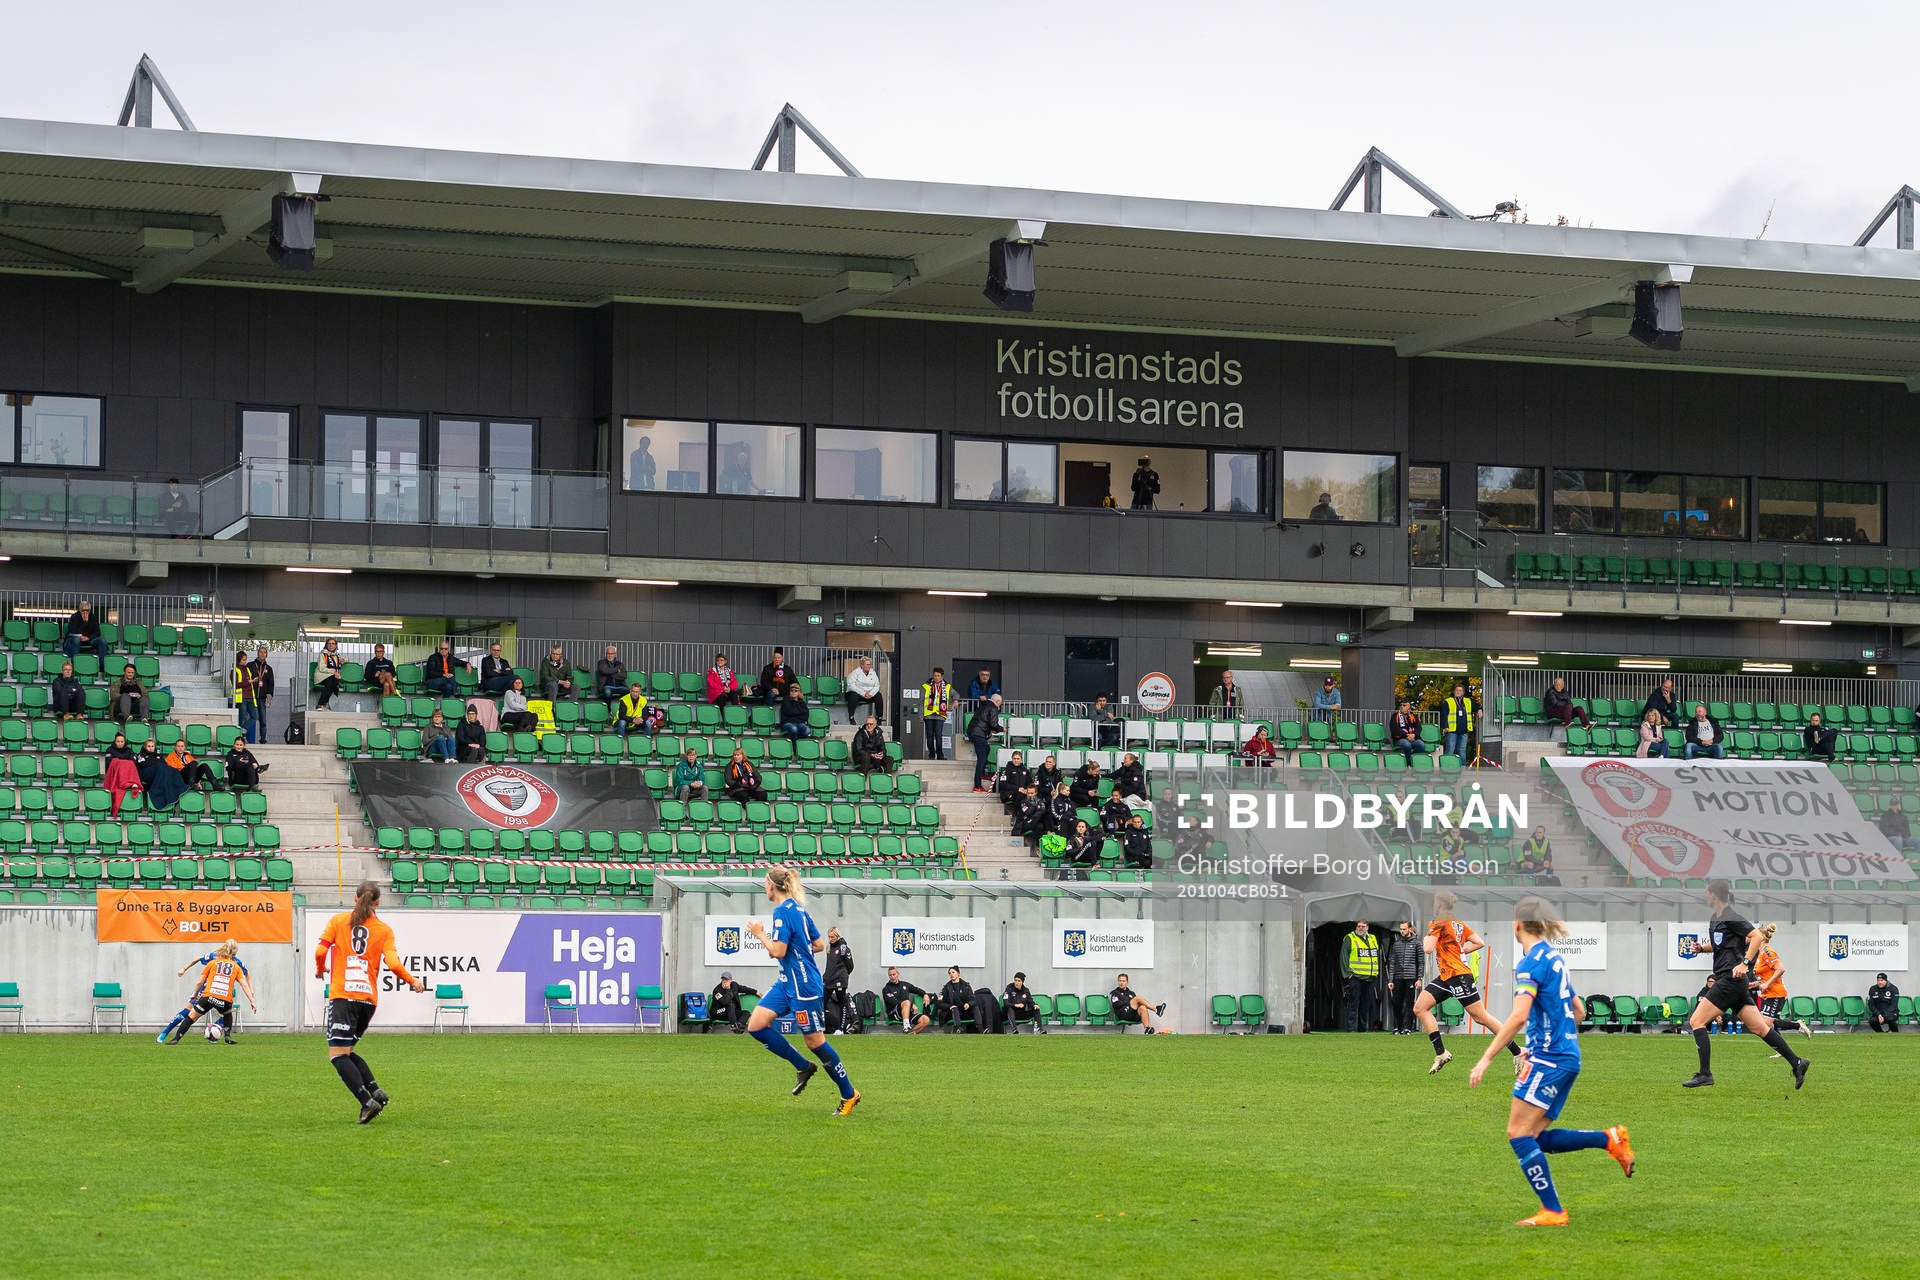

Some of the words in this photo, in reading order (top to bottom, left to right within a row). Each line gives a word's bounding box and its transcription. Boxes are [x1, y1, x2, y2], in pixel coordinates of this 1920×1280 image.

[997, 338, 1243, 386] Kristianstads
[997, 382, 1244, 429] fotbollsarena
[462, 767, 533, 793] KRISTIANSTADS
[1674, 766, 1774, 785] STILL
[1776, 768, 1820, 785] IN
[1692, 790, 1839, 816] MOTION
[503, 815, 529, 825] 1998
[1722, 829, 1810, 846] KIDS
[1810, 831, 1860, 846] IN
[1735, 851, 1890, 878] MOTION
[116, 900, 150, 913] Önne
[153, 901, 172, 913] Trä
[176, 902, 185, 913] &
[189, 902, 253, 916] Byggvaror
[256, 902, 275, 913] AB
[179, 921, 230, 932] BOLIST
[351, 925, 369, 955] 8
[919, 931, 975, 943] Kristianstads
[1089, 933, 1144, 944] Kristianstads
[1851, 938, 1900, 948] Kristianstads
[552, 926, 636, 970] Heja
[919, 942, 957, 952] kommun
[1089, 943, 1127, 953] kommun
[1556, 946, 1582, 955] mmun
[1851, 947, 1885, 956] kommun
[216, 961, 234, 976] 18
[557, 970, 631, 1006] alla!
